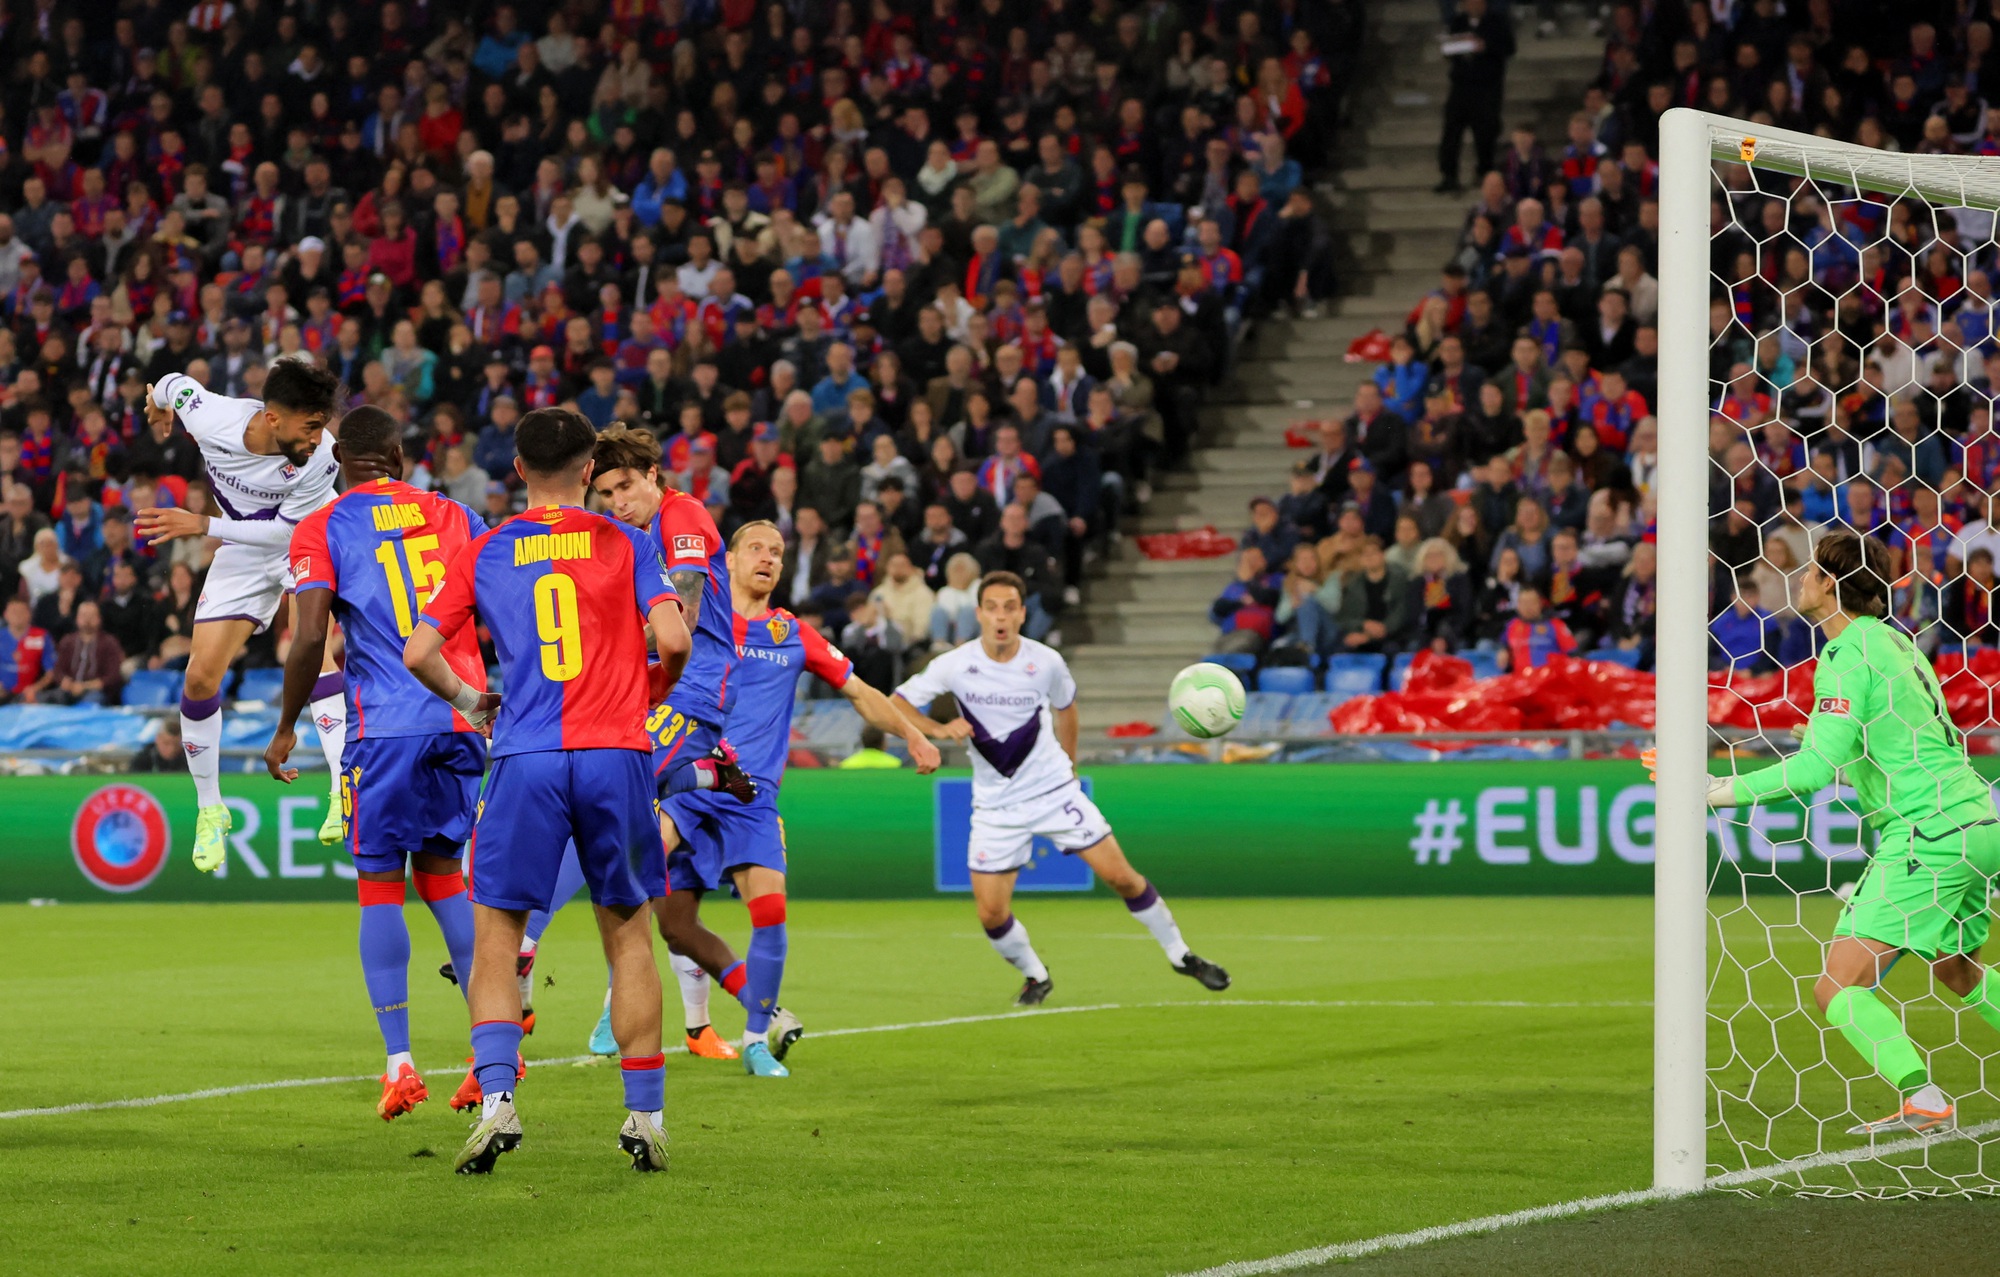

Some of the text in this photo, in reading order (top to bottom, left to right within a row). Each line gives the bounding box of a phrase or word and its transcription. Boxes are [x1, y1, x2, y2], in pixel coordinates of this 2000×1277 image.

[206, 460, 285, 500] Mediacom
[371, 502, 426, 532] ADAMS
[542, 510, 563, 520] 1893
[513, 531, 592, 567] AMDOUNI
[676, 538, 702, 549] CIC
[374, 534, 446, 638] 15
[534, 573, 583, 682] 9
[965, 692, 1035, 706] Mediacom
[644, 704, 685, 747] 33
[1063, 800, 1085, 826] 5
